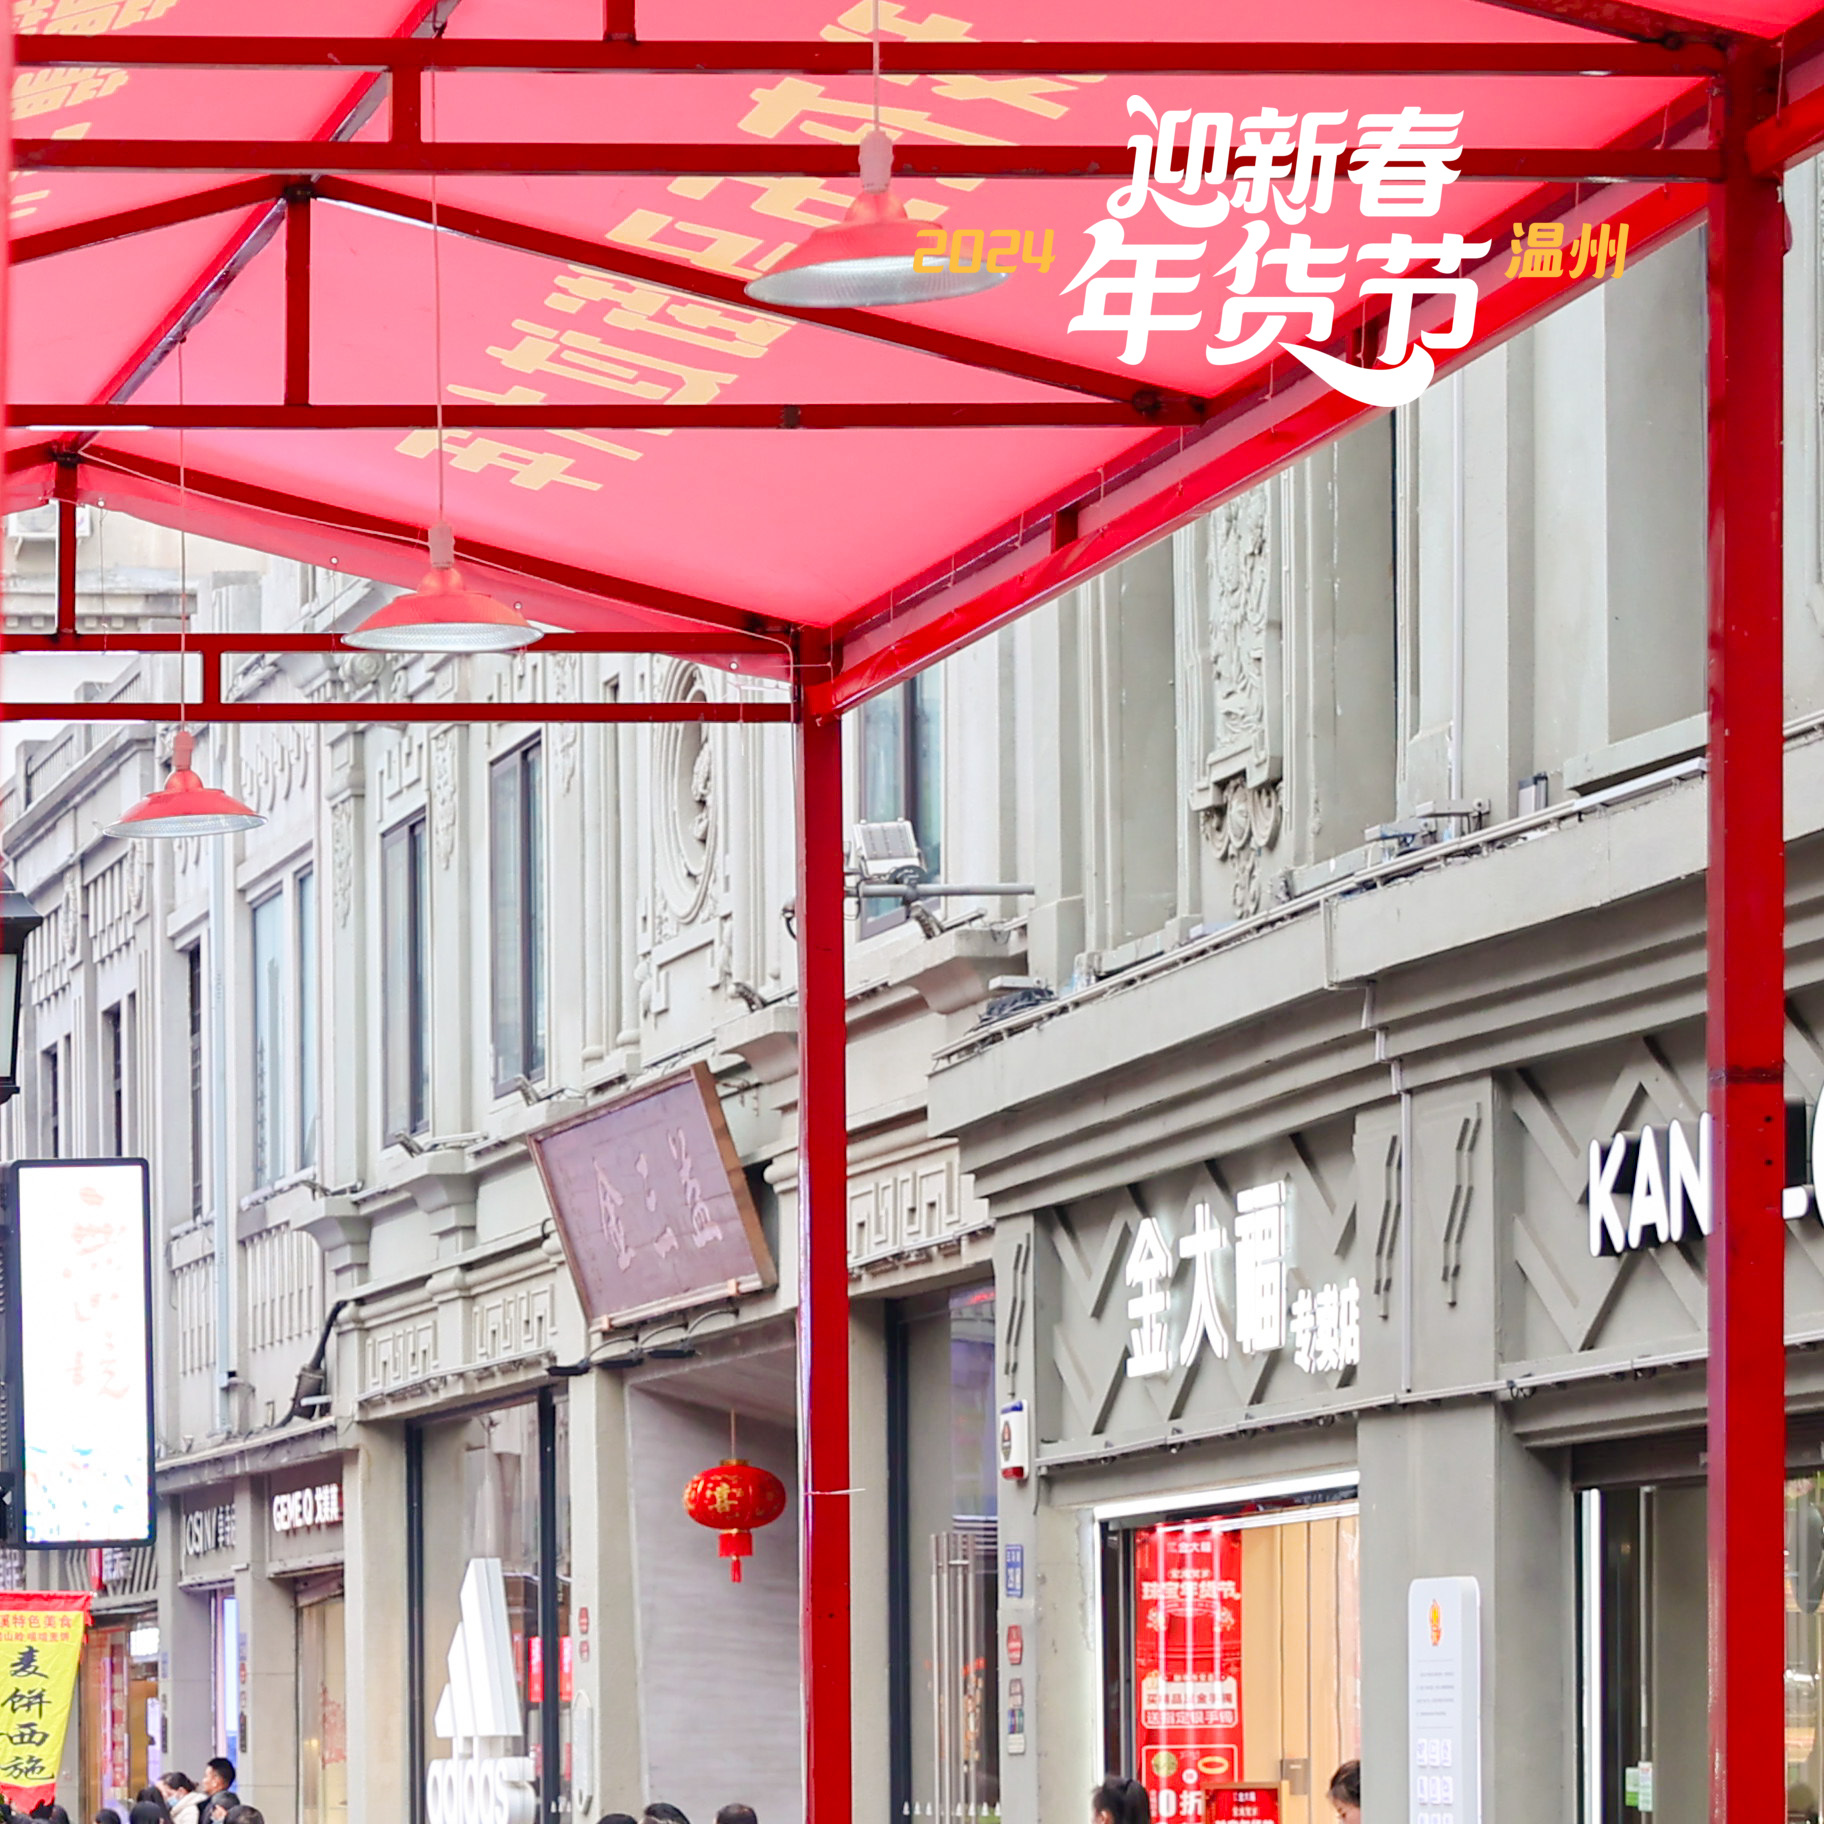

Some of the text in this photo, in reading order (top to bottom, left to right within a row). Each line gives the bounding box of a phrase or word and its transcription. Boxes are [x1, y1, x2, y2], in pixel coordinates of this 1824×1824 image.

[1125, 1180, 1287, 1378] 金大福
[1, 1645, 55, 1780] 麦饼西施
